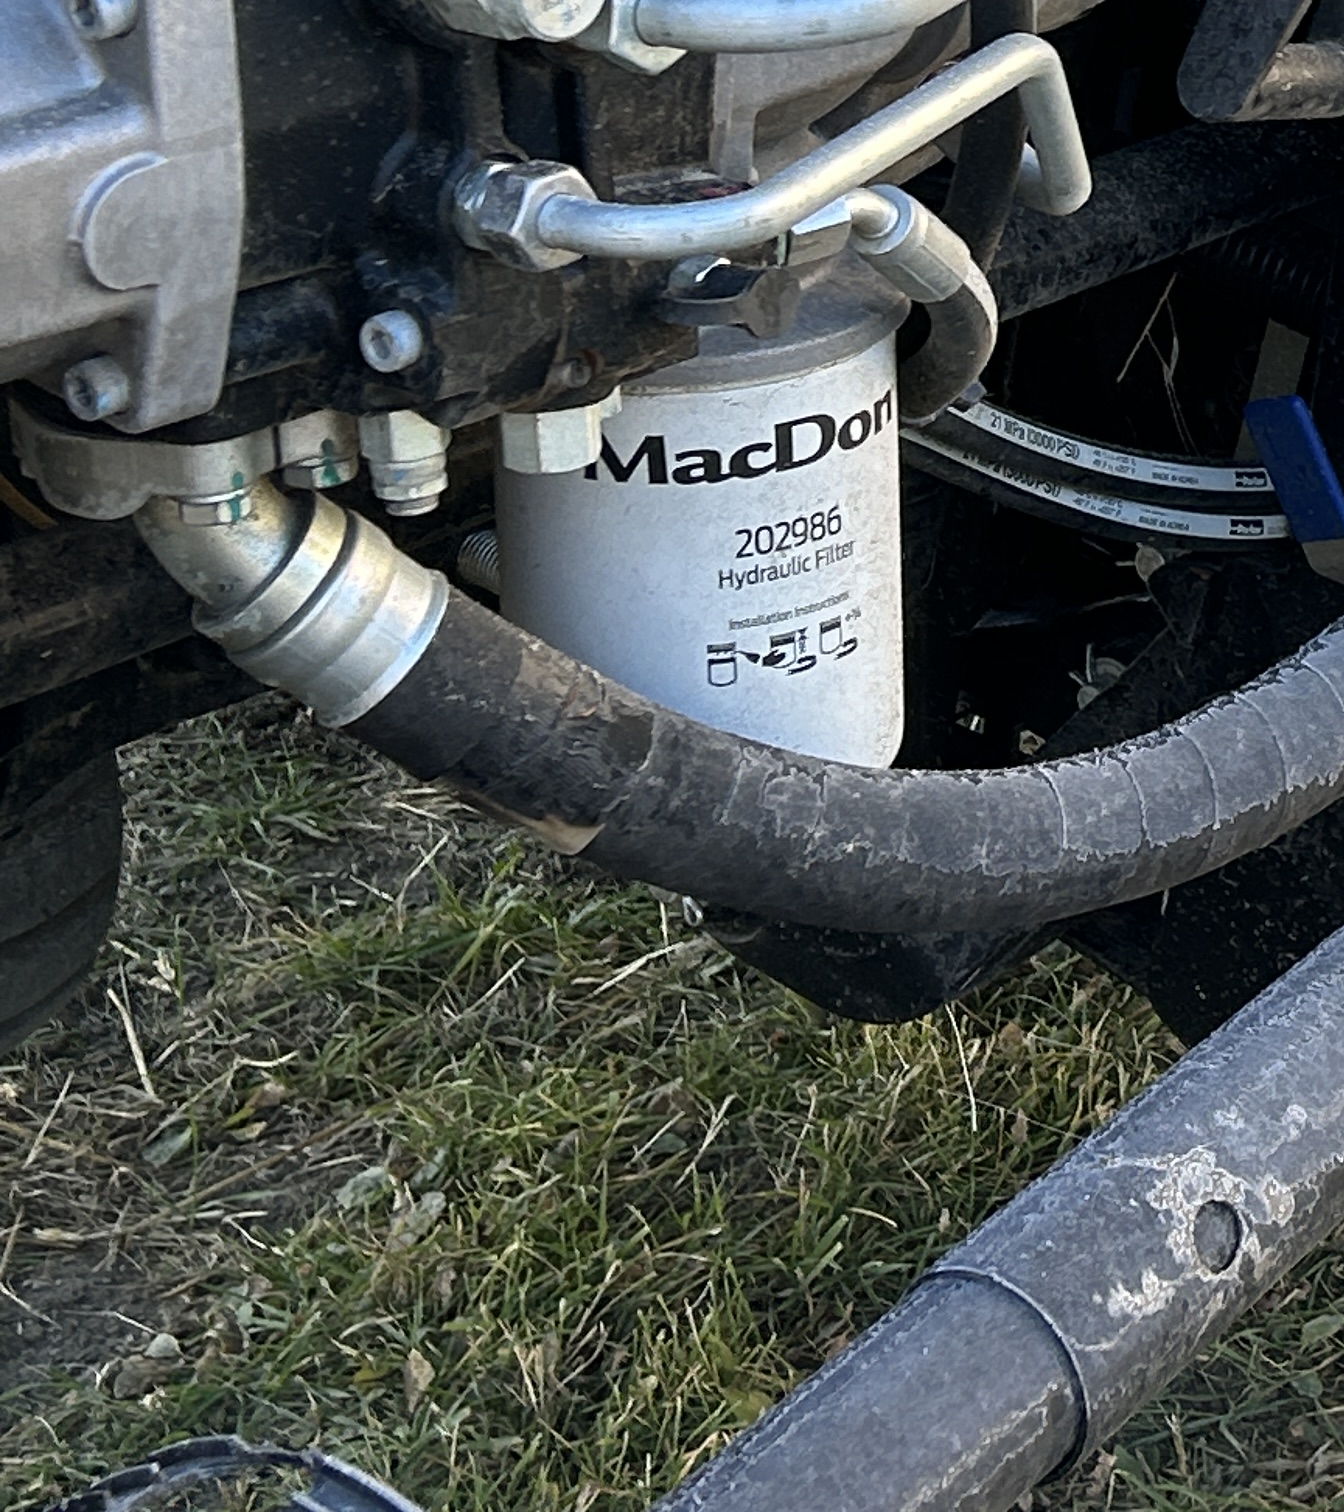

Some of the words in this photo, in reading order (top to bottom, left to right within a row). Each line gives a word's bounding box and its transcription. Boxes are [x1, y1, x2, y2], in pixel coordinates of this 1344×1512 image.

[583, 389, 893, 485] MacDon
[735, 504, 843, 560] 202986
[718, 554, 812, 590] Hydraulic
[815, 539, 855, 571] Filter
